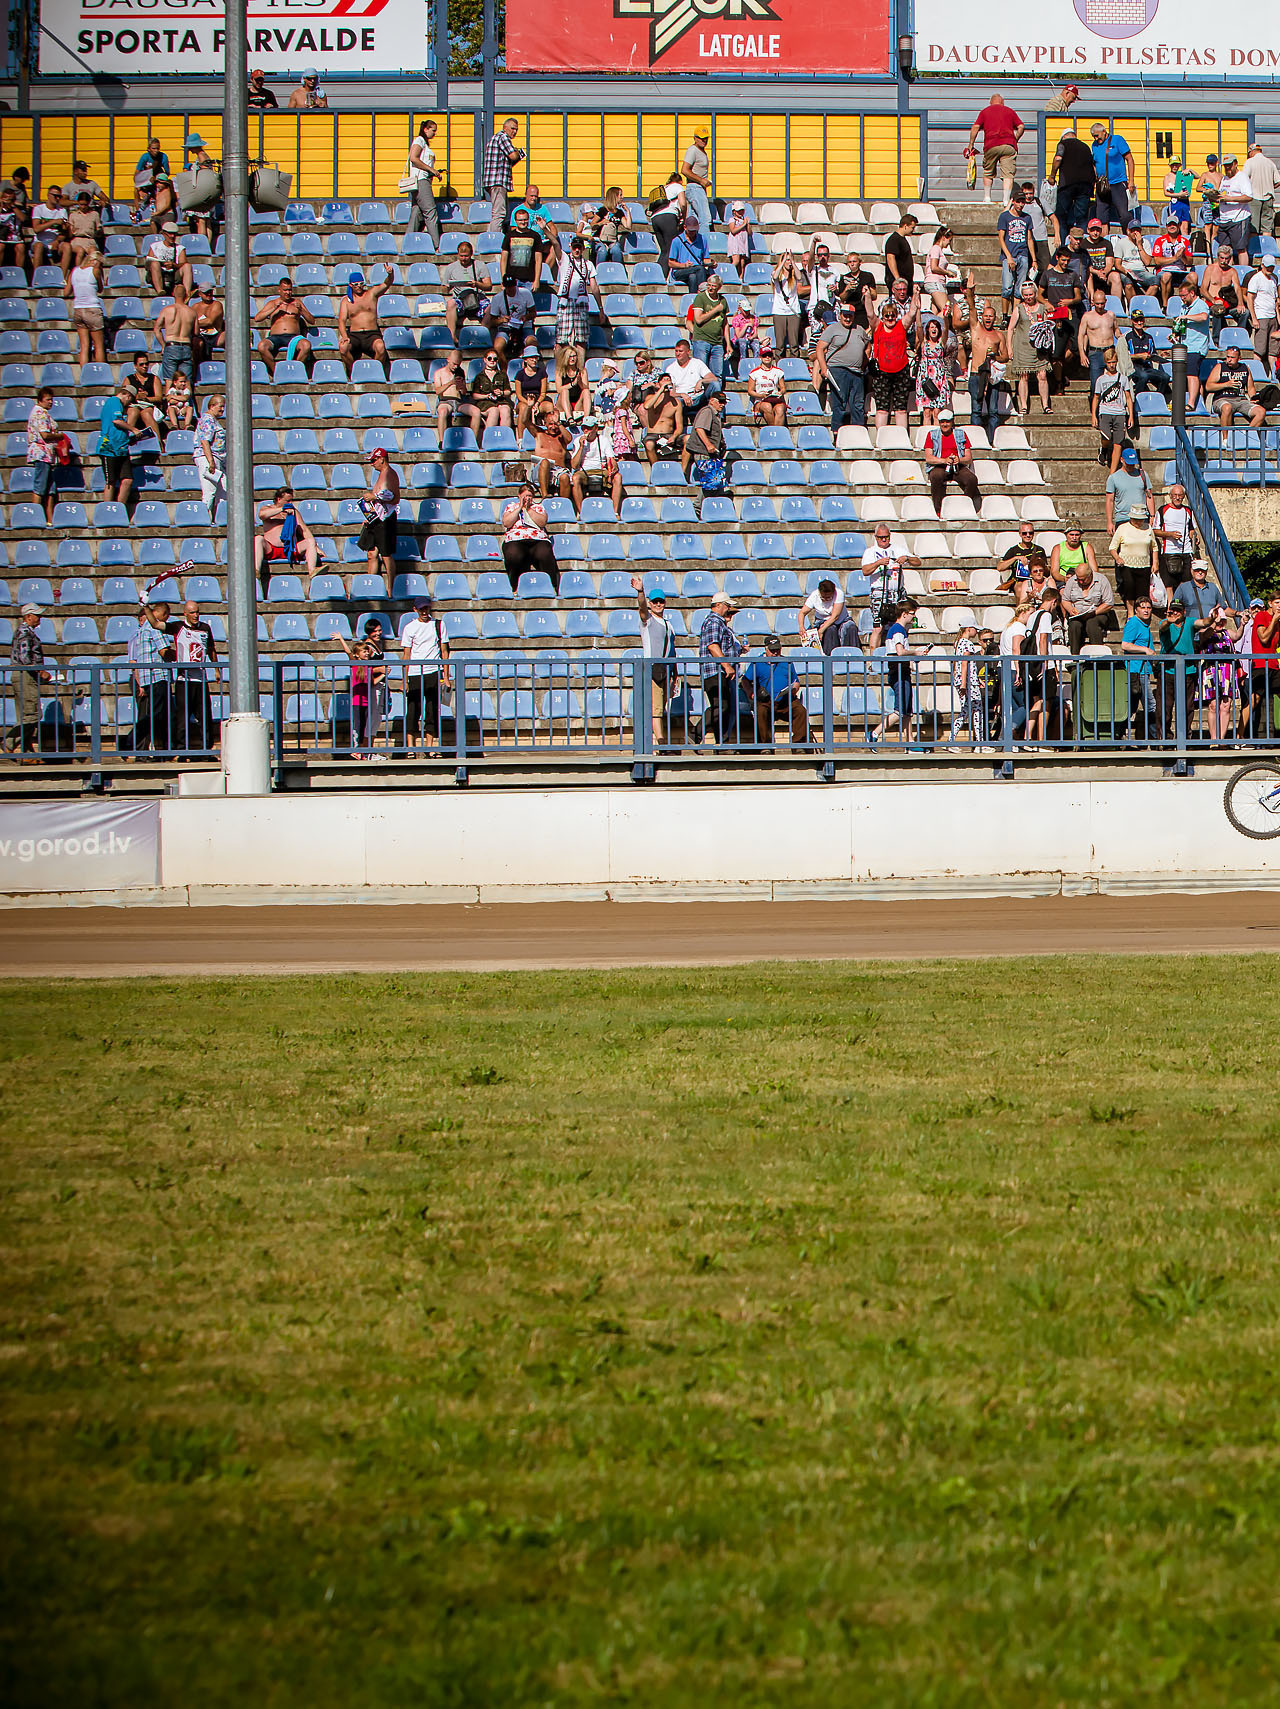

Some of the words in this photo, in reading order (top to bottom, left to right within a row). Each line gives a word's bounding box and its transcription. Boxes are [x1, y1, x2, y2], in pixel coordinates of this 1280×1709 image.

[77, 29, 202, 54] SPORTA
[213, 28, 376, 53] PRVALDE
[699, 33, 781, 58] LATGALE
[928, 44, 1088, 65] DAUGAVPILS
[1100, 43, 1216, 66] PILSĒTAS
[1155, 131, 1173, 159] H
[145, 504, 156, 512] 27
